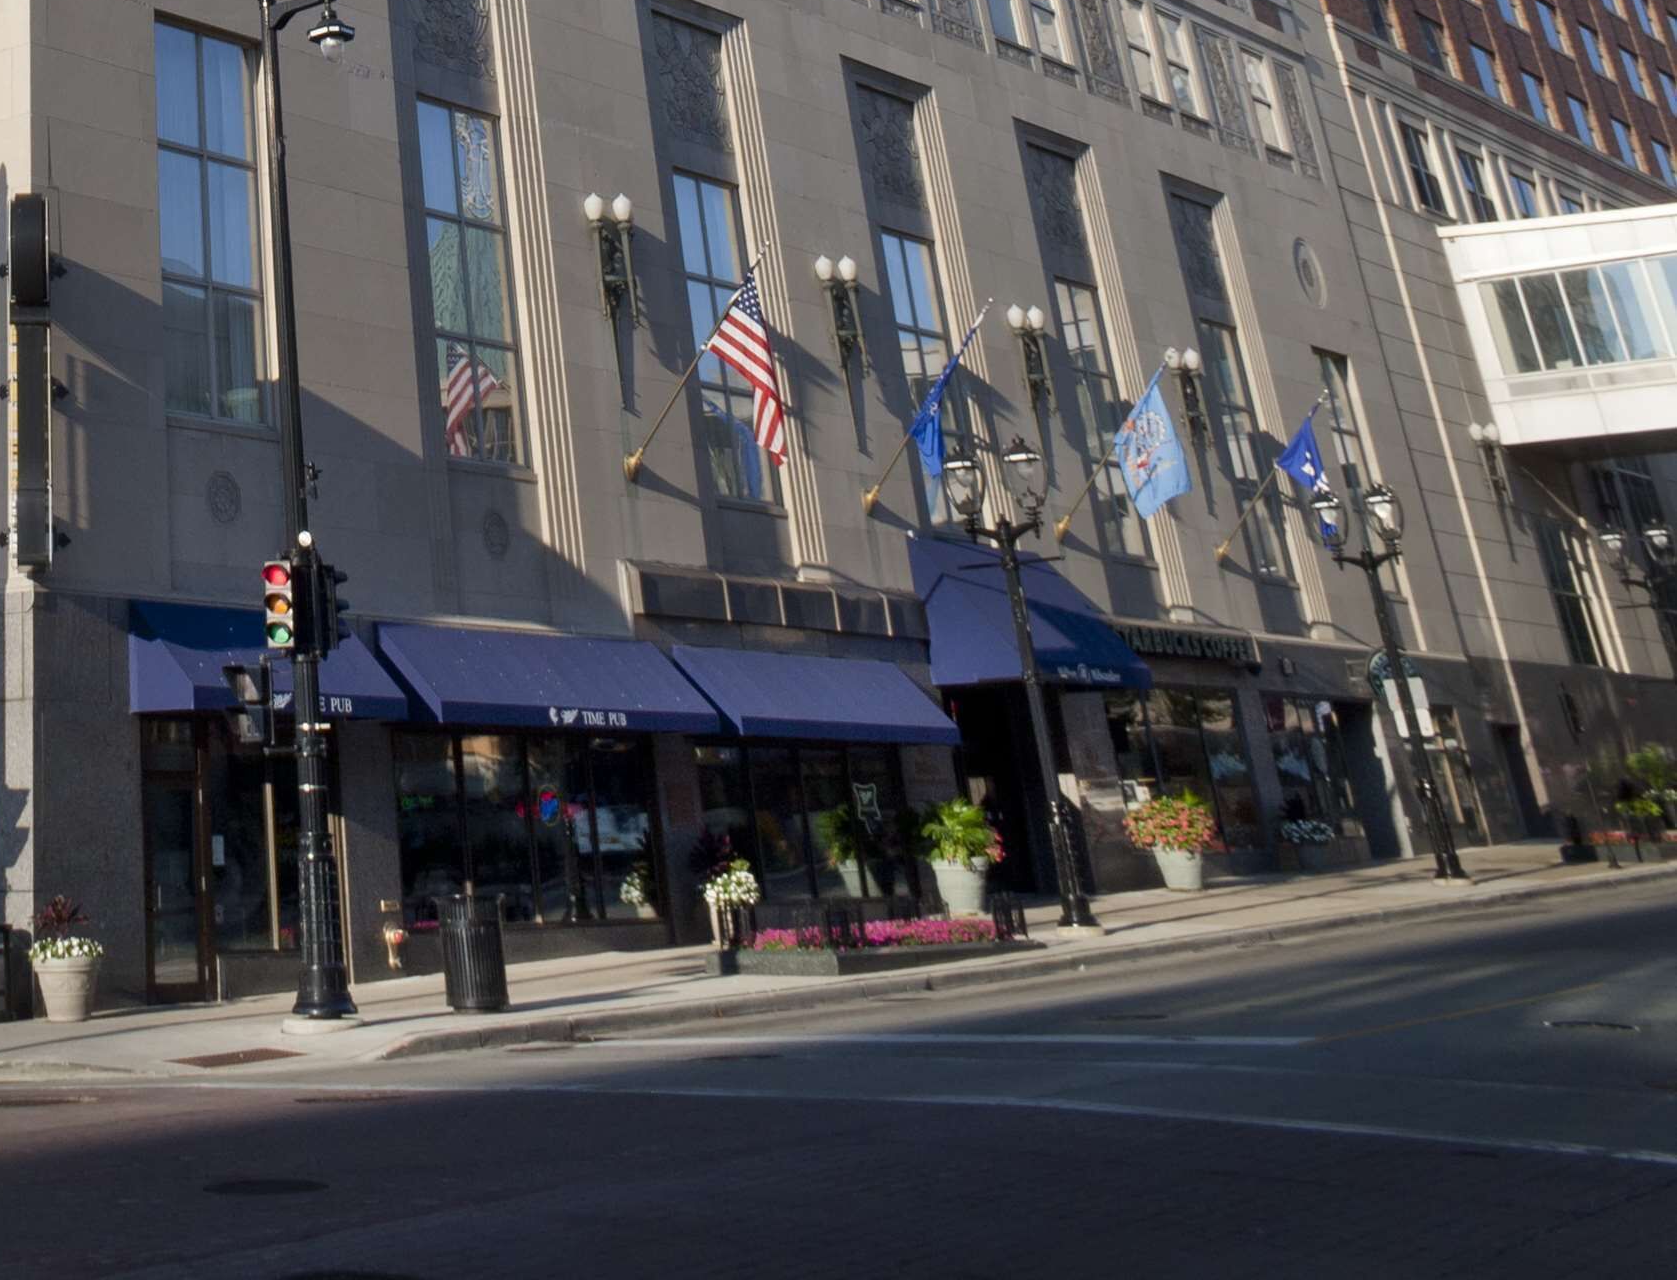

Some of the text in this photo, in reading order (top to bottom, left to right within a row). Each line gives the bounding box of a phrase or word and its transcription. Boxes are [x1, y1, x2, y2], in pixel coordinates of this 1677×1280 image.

[330, 697, 353, 713] PUB
[582, 710, 606, 726] TIME
[608, 711, 627, 727] PUB
